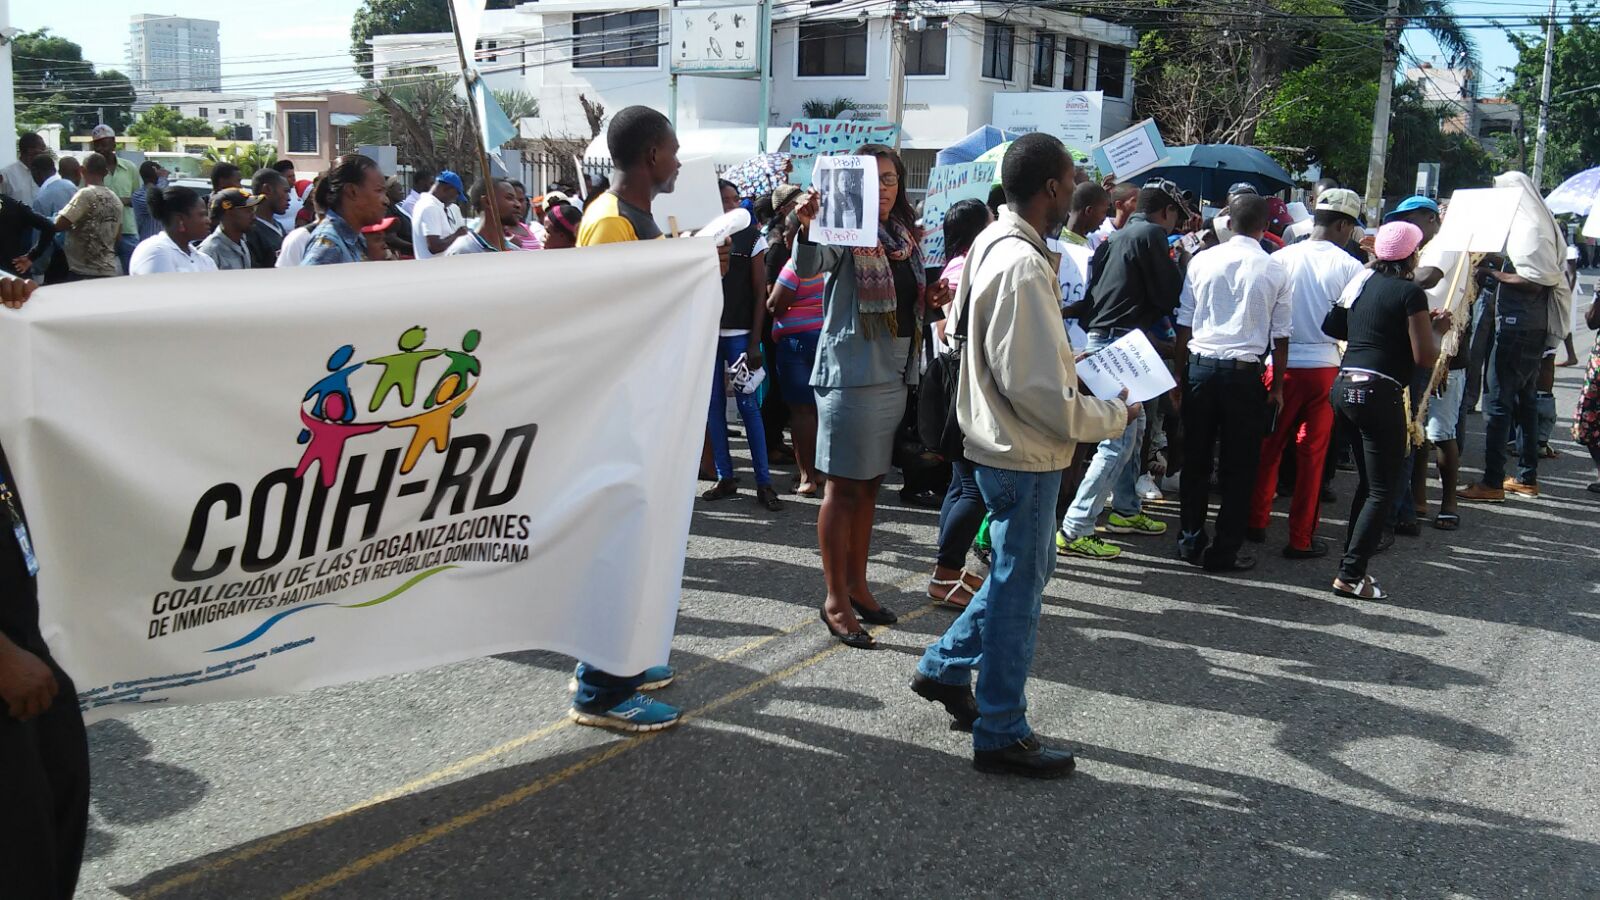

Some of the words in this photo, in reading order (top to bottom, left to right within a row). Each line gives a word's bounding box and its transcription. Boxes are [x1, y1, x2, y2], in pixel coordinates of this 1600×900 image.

[171, 423, 538, 582] COIH-RD
[148, 617, 173, 640] DE
[172, 594, 278, 633] INMIGRANTES
[277, 571, 350, 607] HAITIANOS
[351, 566, 374, 586] EN
[374, 551, 441, 579] REPÚBLICA
[444, 542, 530, 564] DOMINICANA
[152, 572, 282, 615] COALICIÓN
[284, 562, 315, 588] DE
[316, 549, 358, 578] LAS
[359, 514, 532, 565] ORGANIZACIONES
